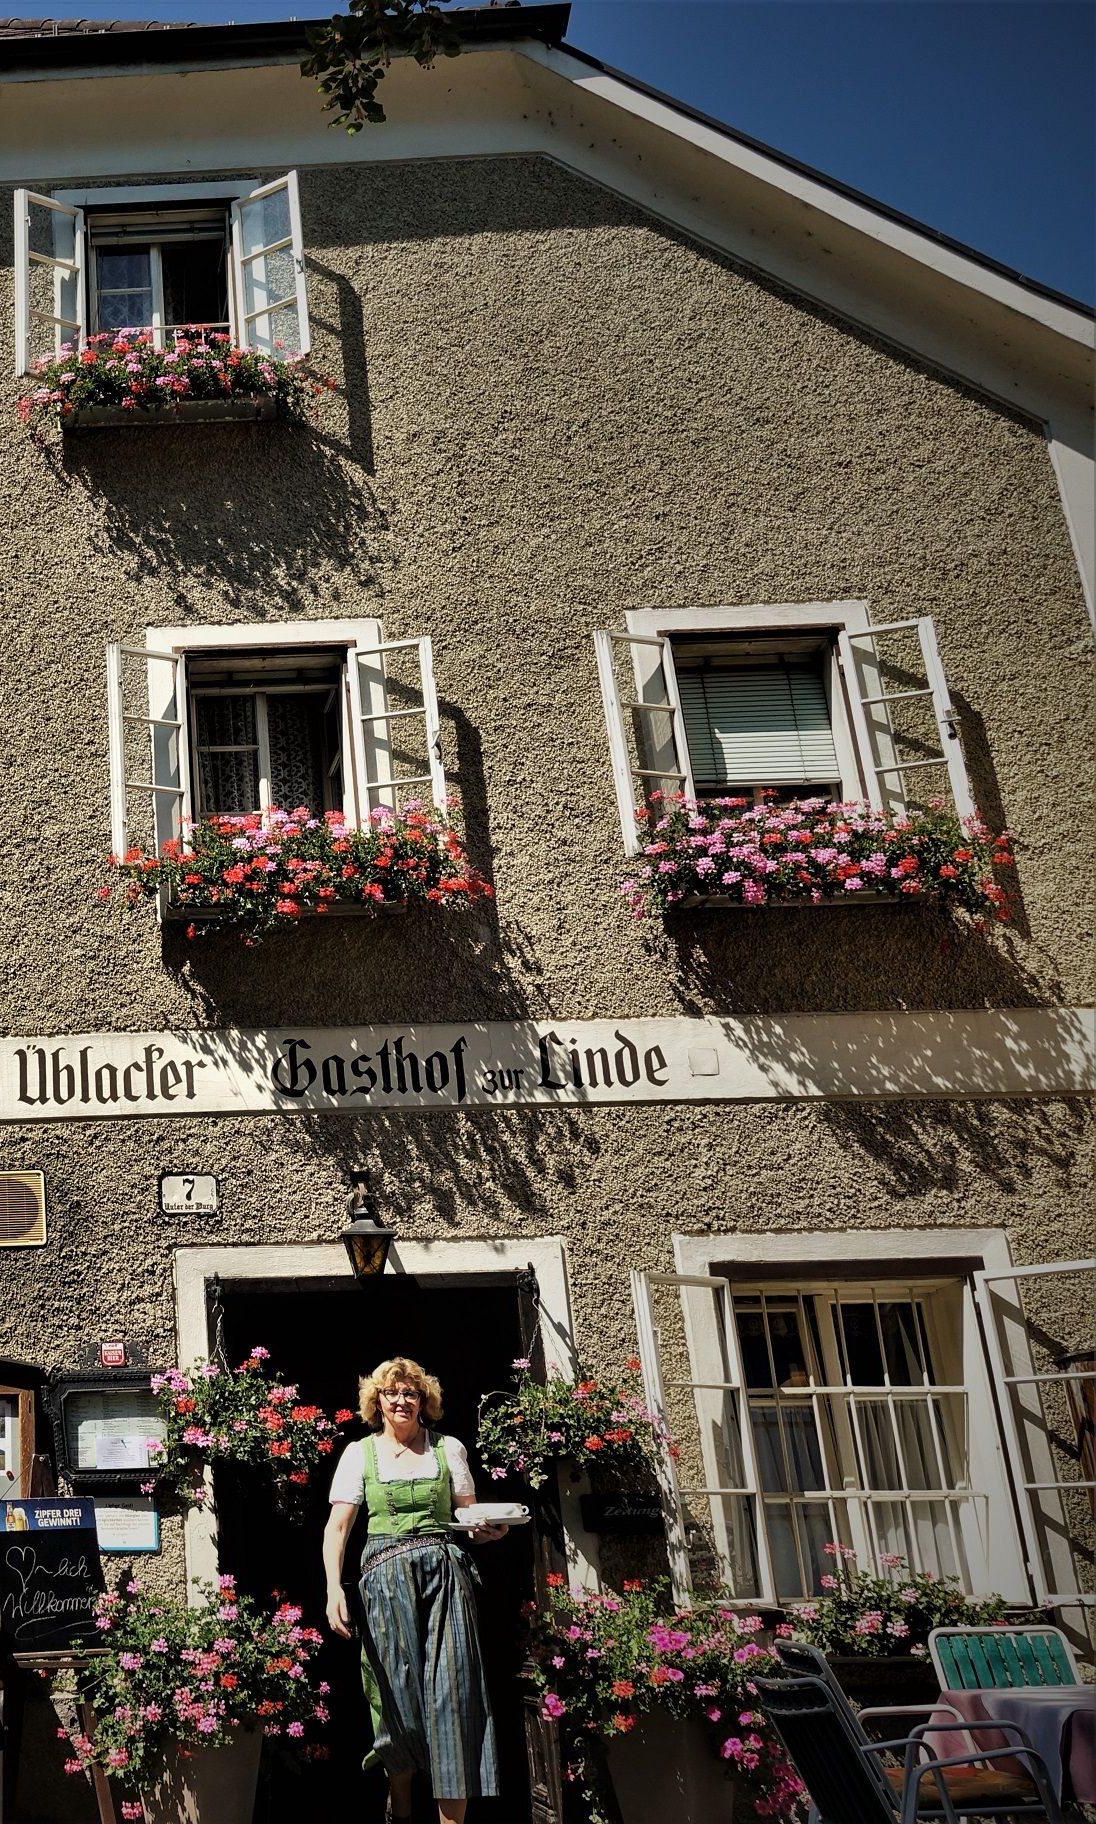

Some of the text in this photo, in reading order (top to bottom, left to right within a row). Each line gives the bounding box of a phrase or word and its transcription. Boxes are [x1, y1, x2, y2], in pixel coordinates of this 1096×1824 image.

[13, 1044, 207, 1105] Üblacker
[270, 1035, 469, 1103] Gasthof
[482, 1066, 524, 1095] zur
[538, 1029, 668, 1090] Linde
[182, 1177, 195, 1201] 7
[164, 1202, 214, 1211] Unter der Burg
[34, 1508, 82, 1519] ZIPFER DREI
[37, 1517, 81, 1527] GEWINNT!
